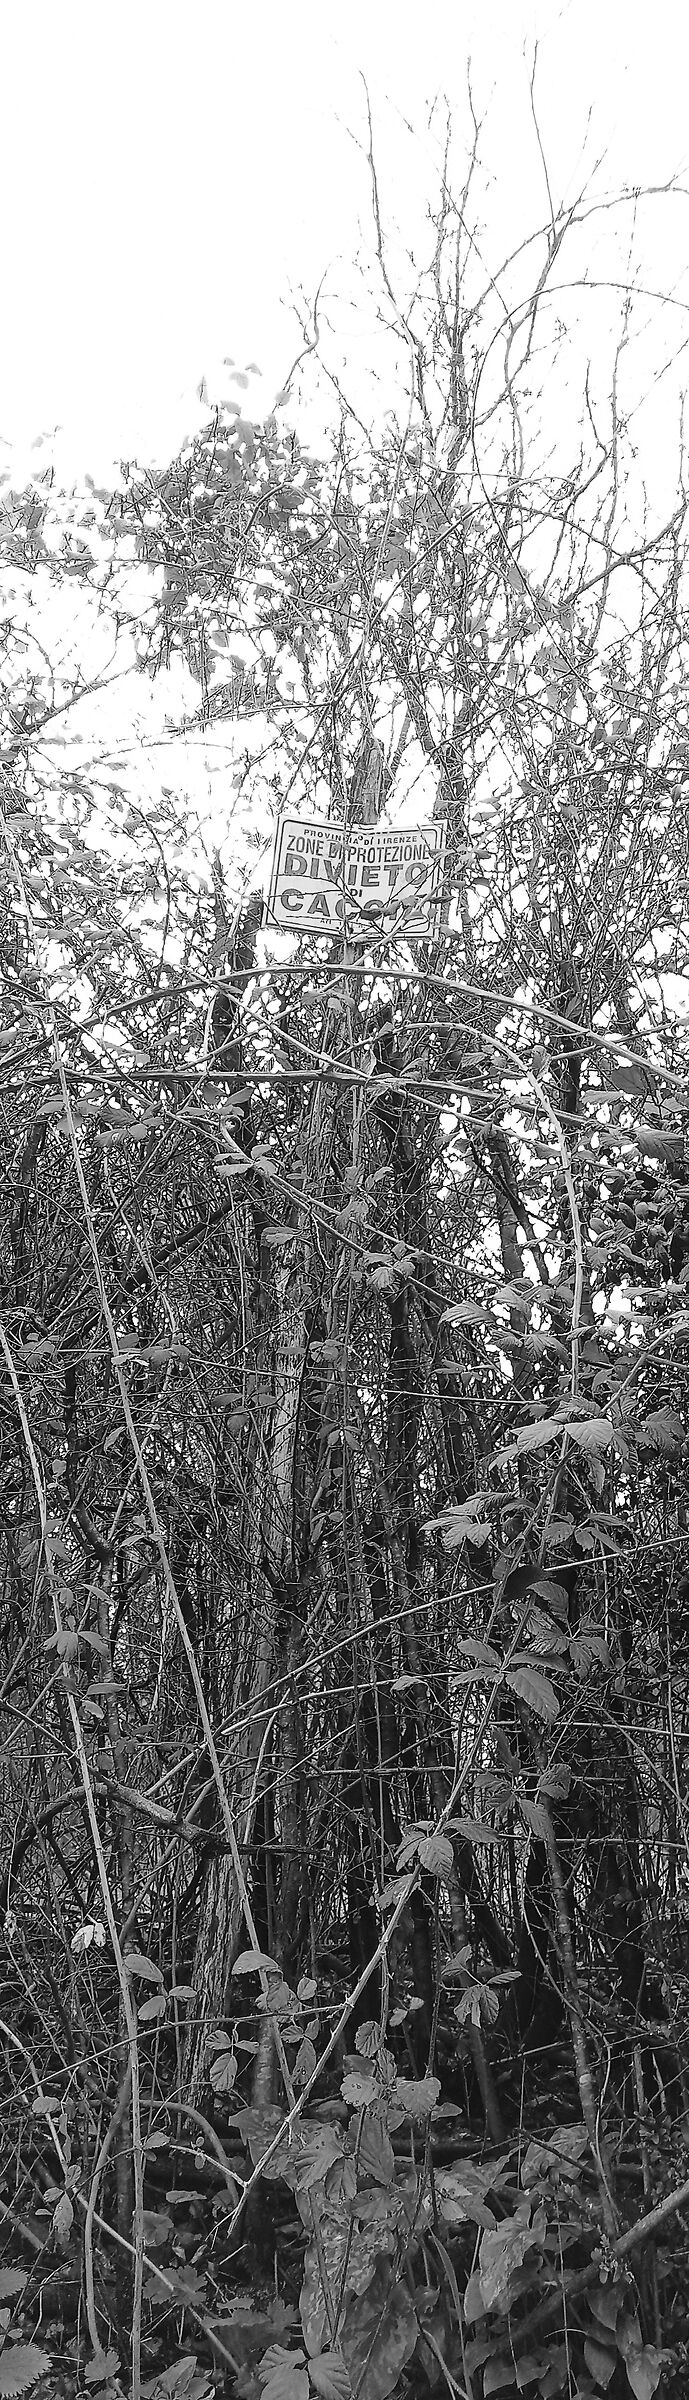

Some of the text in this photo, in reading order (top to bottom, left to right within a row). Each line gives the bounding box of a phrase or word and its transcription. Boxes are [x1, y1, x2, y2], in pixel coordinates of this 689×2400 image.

[287, 835, 323, 856] ZONE
[347, 844, 430, 863] PROTEZIONE
[303, 829, 359, 845] PROVINIA
[284, 853, 428, 888] DIVIETO
[280, 888, 427, 920] CAC
[350, 888, 363, 898] DI
